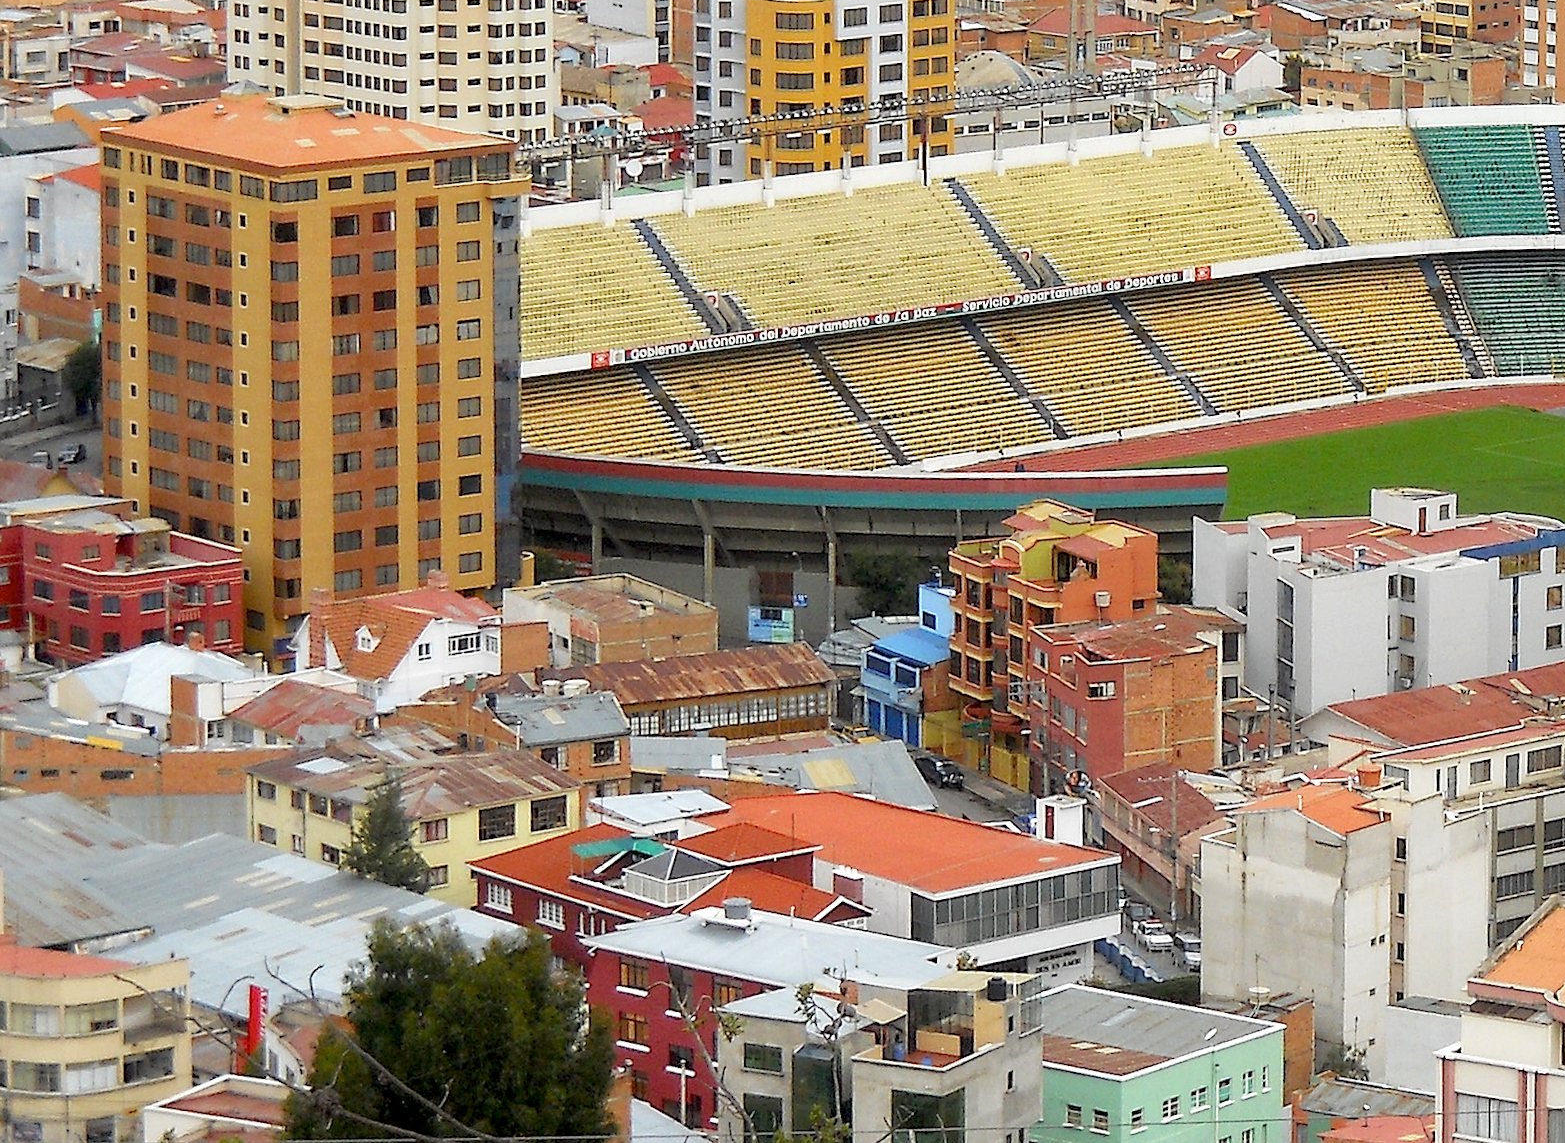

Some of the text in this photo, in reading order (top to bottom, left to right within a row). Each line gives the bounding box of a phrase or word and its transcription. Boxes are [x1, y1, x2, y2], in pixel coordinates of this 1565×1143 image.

[630, 342, 687, 360] Gobierno
[759, 329, 778, 341] del
[781, 318, 870, 338] Departamento
[893, 310, 909, 323] La
[962, 296, 1010, 312] Servicio
[1013, 283, 1103, 305] Departamental
[1124, 272, 1178, 289] Deportes
